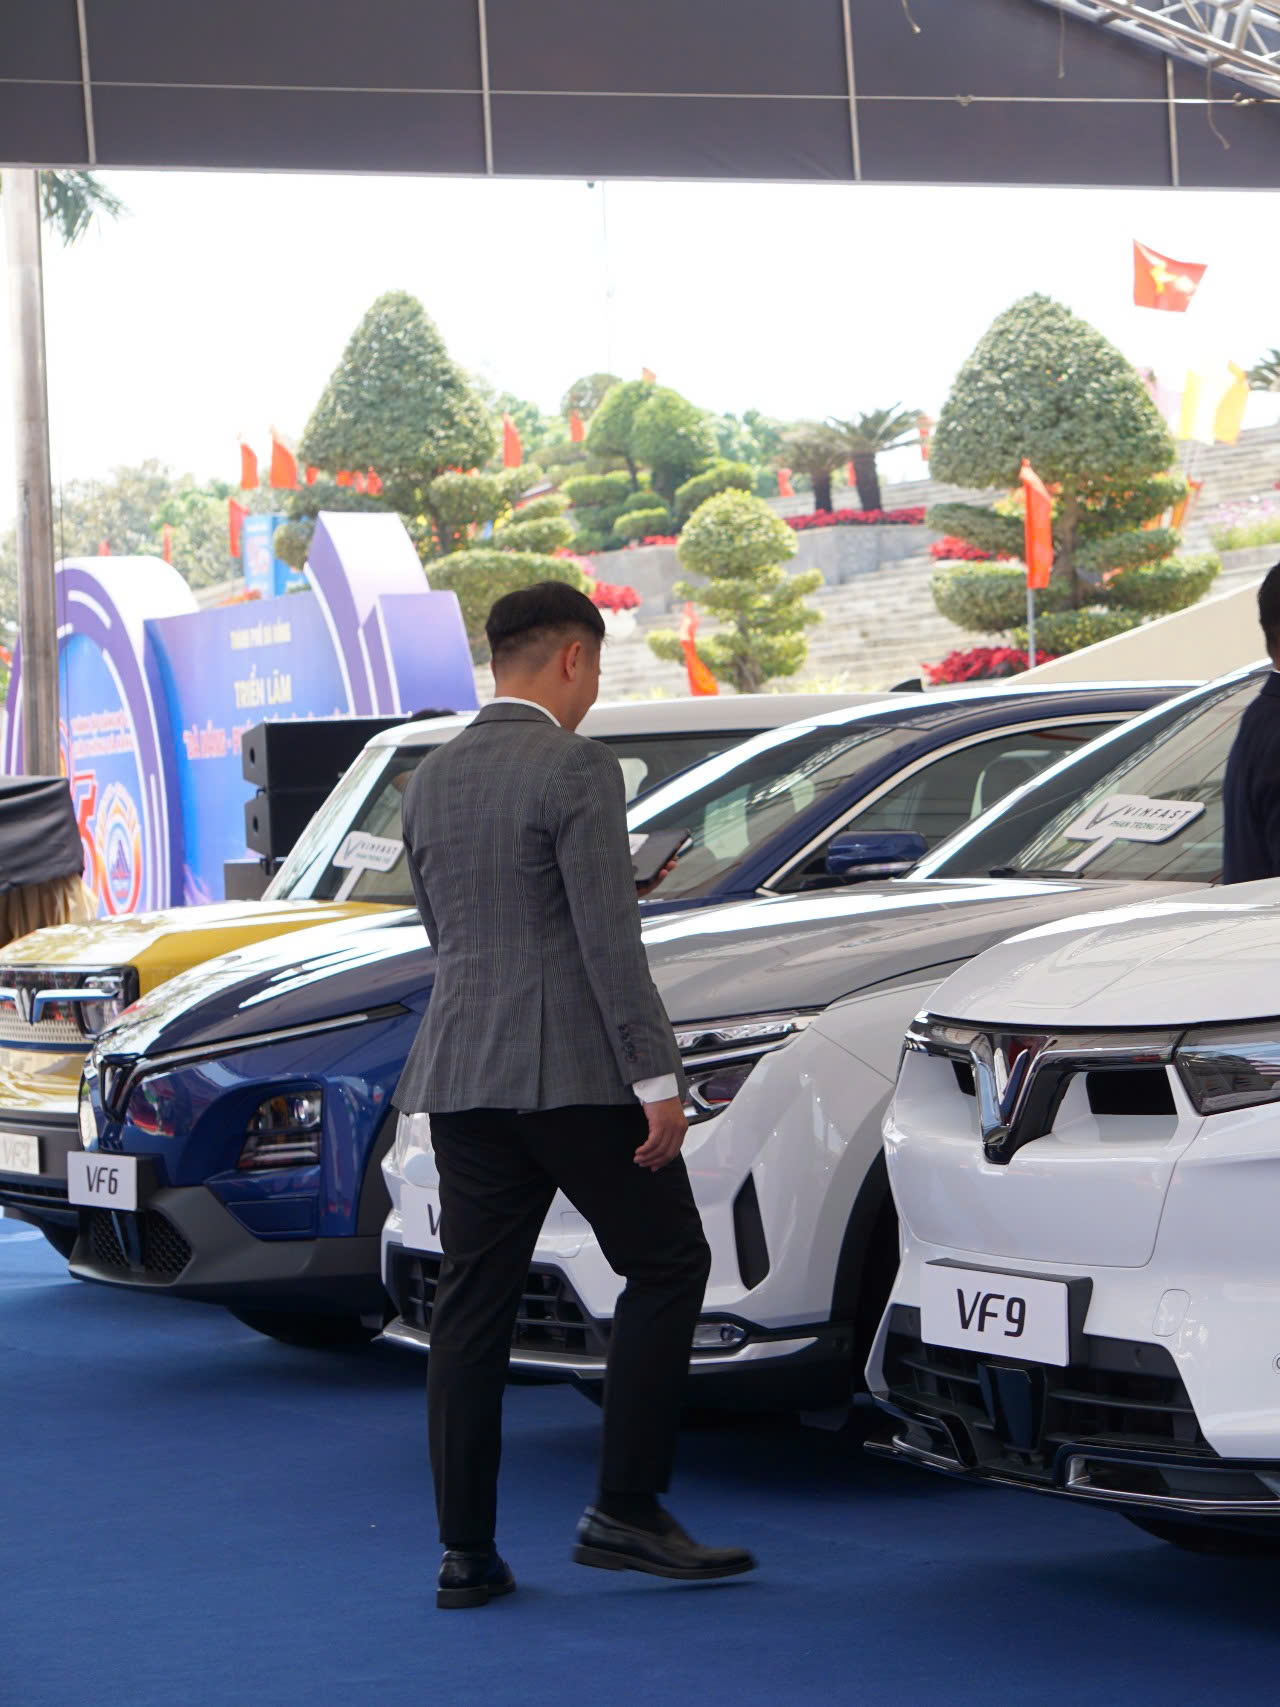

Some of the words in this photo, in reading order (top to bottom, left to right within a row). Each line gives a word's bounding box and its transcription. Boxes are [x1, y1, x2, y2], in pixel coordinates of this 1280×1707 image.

[1123, 807, 1191, 819] VINFAST
[86, 1165, 119, 1195] VF6
[956, 1288, 1026, 1338] VF9
